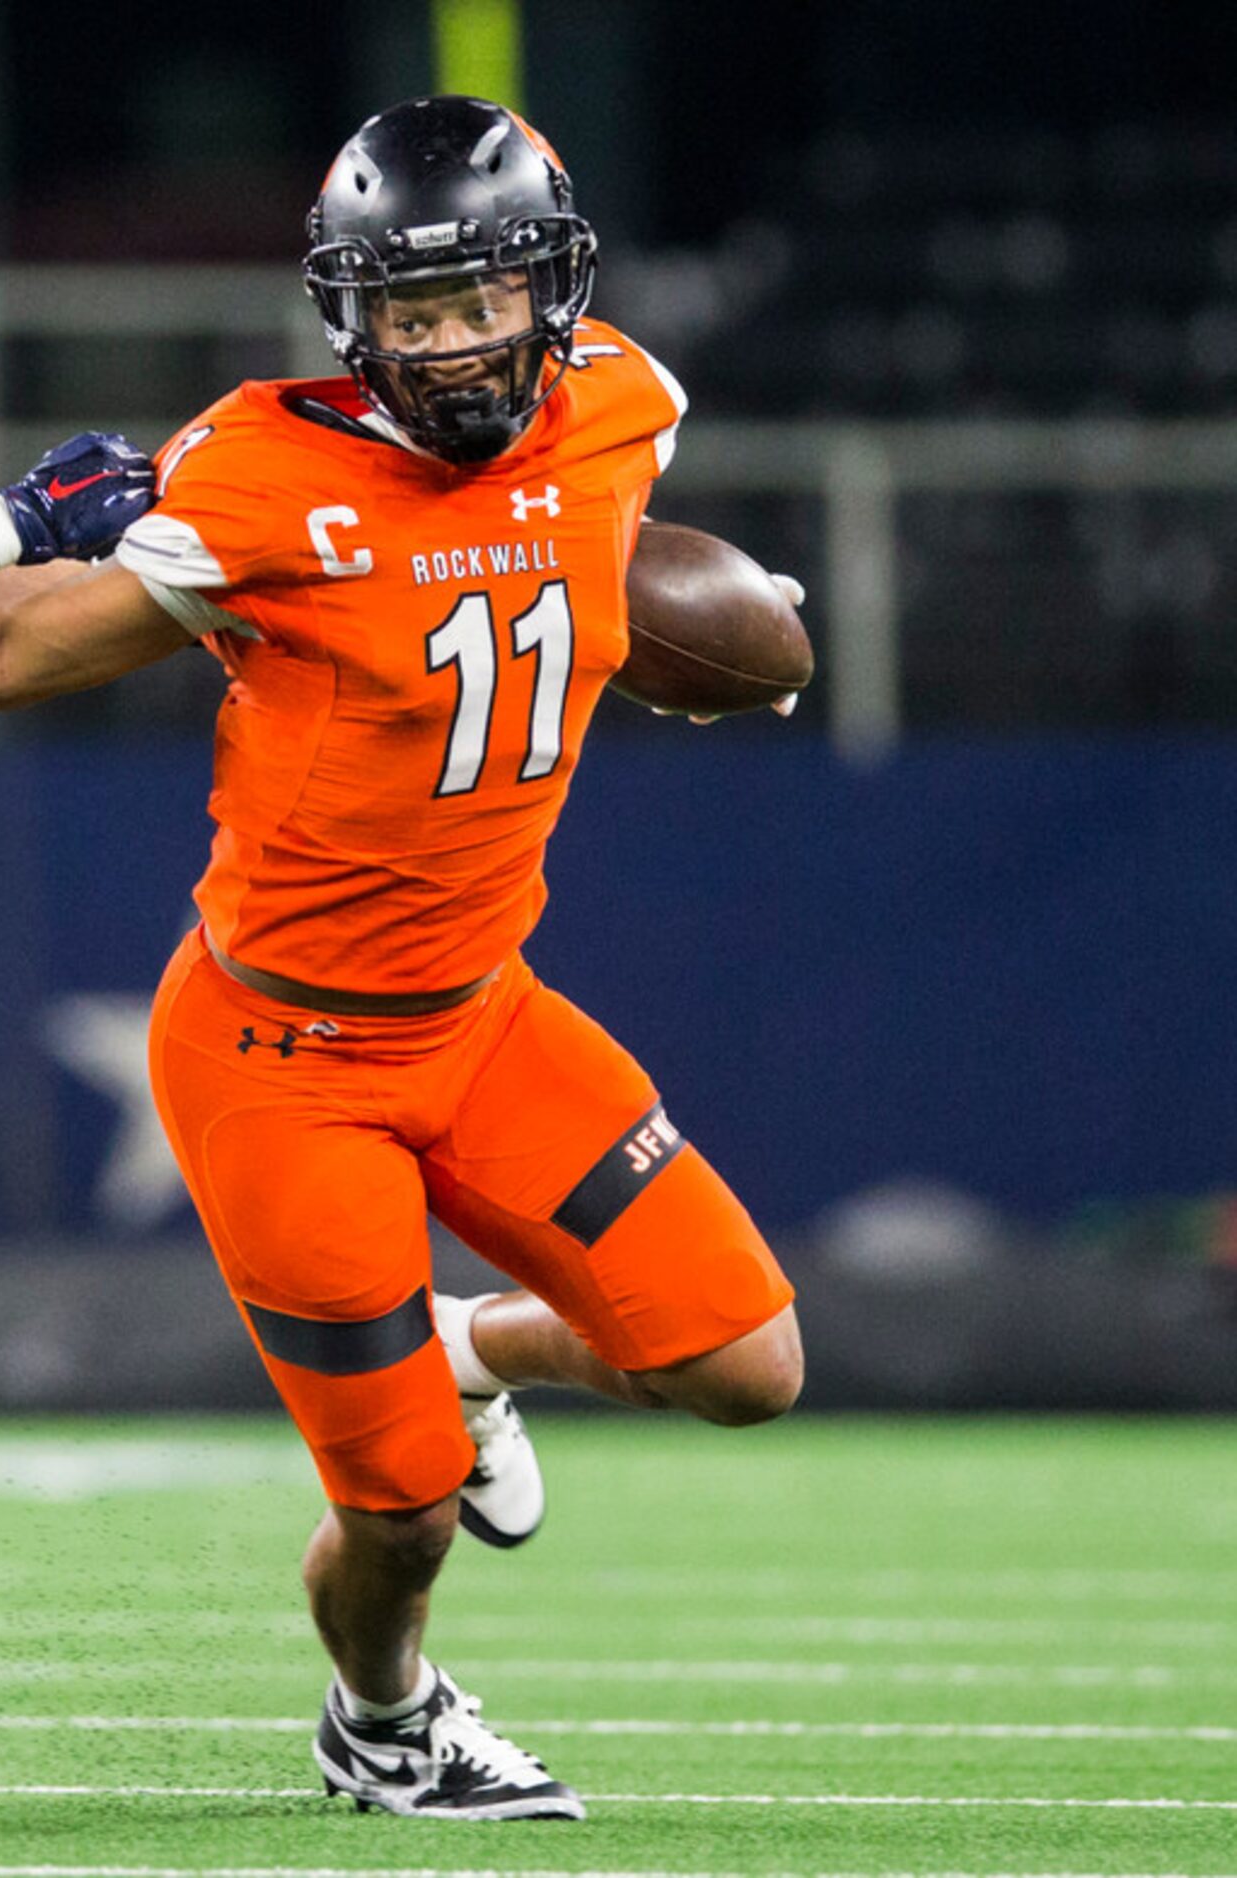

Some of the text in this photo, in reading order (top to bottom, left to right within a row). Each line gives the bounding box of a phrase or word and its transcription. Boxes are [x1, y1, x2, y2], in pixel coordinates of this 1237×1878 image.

[306, 504, 372, 576] C
[412, 538, 559, 586] ROCKWALL
[425, 578, 574, 798] 11
